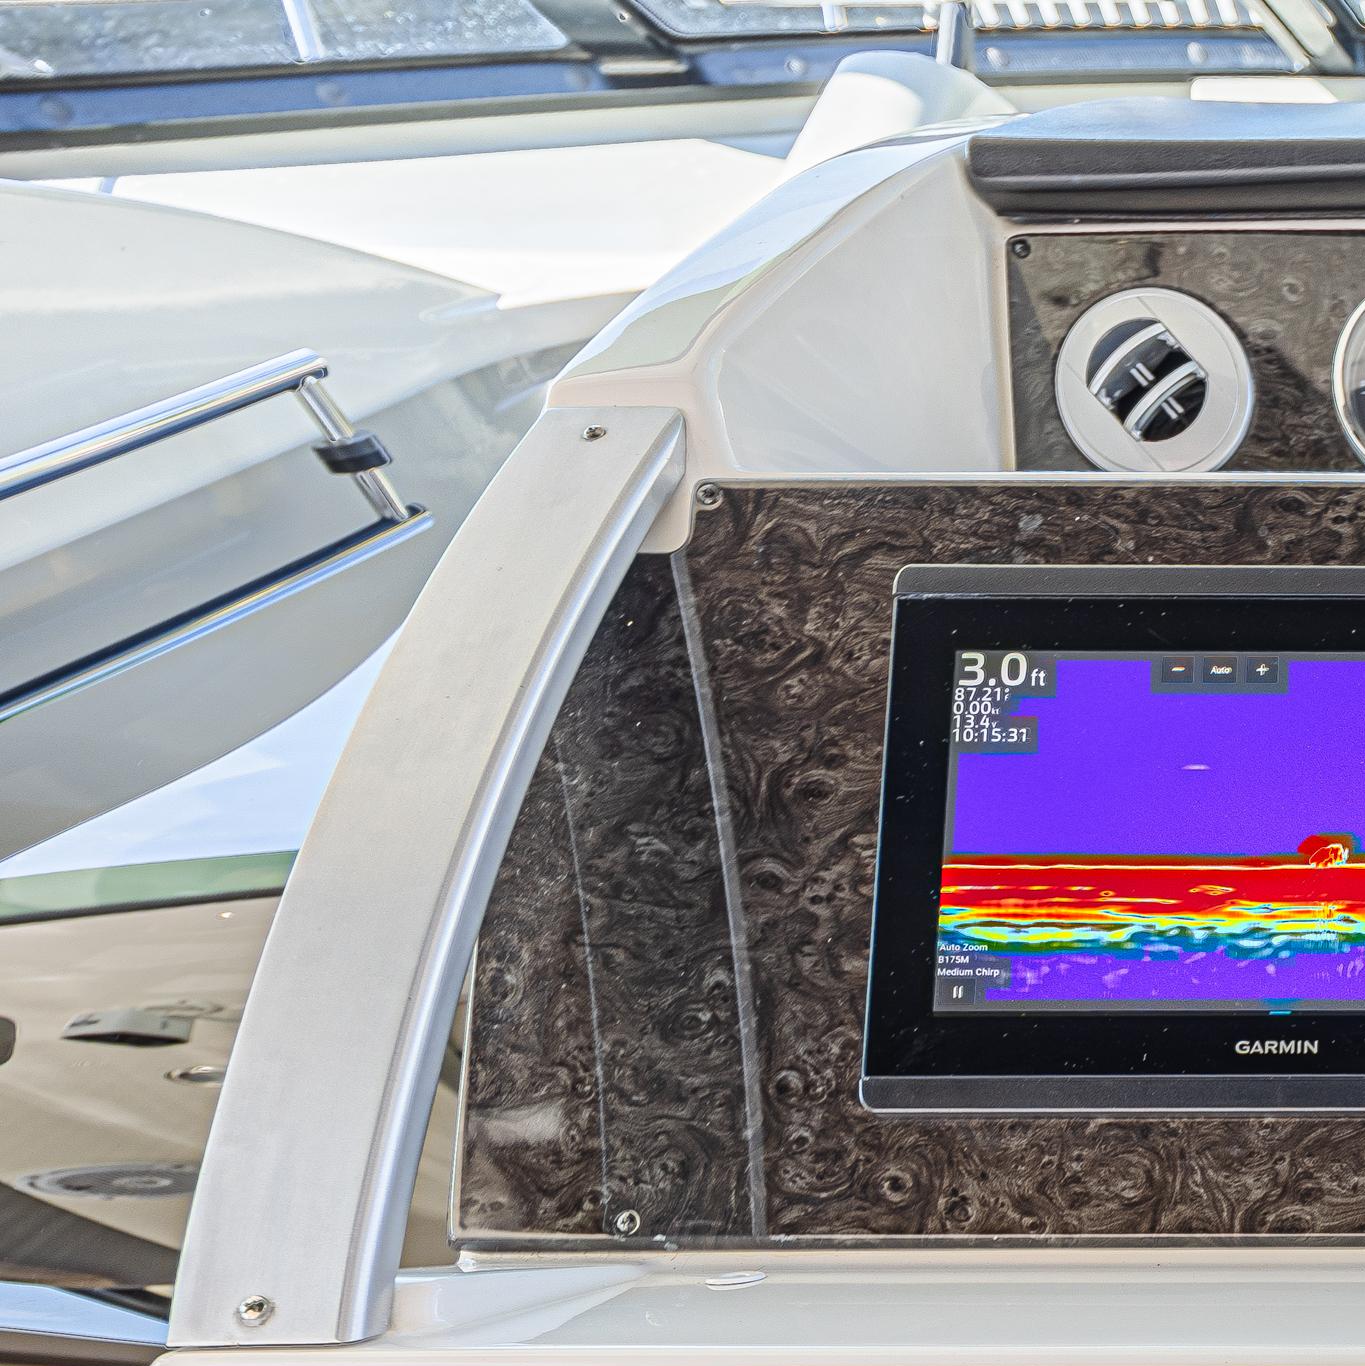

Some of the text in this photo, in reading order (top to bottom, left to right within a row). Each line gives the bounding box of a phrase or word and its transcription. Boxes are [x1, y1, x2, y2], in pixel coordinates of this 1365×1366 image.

[958, 652, 1027, 686] 3.0
[976, 968, 999, 978] Chirp
[1234, 1040, 1319, 1057] GARMIN
